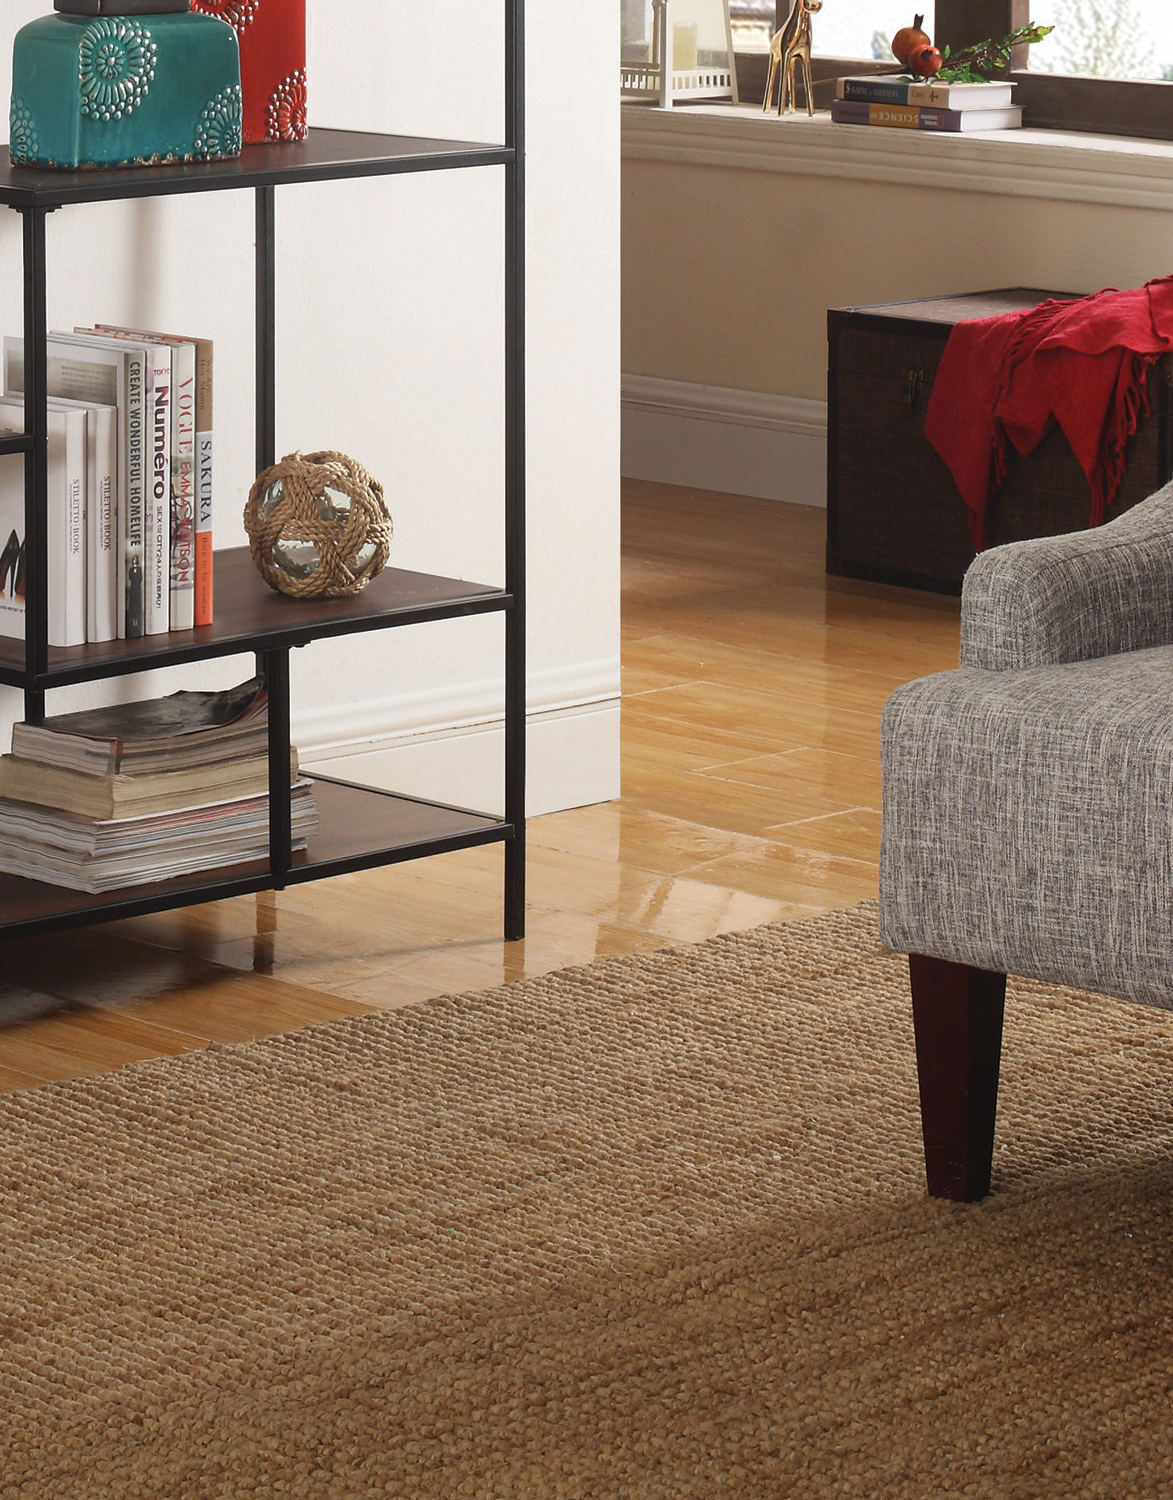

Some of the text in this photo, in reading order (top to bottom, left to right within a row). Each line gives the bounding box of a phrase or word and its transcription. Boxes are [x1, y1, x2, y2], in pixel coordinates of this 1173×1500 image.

[878, 111, 920, 124] SCIENCE
[129, 361, 141, 547] CREATE WONDERFUL HOMELIFE
[153, 386, 169, 500] Numéro
[178, 377, 193, 454] VOGUE
[103, 476, 112, 551] STILETTO BOOK
[177, 461, 192, 583] EMMA WATSON
[200, 440, 212, 523] SAKURA
